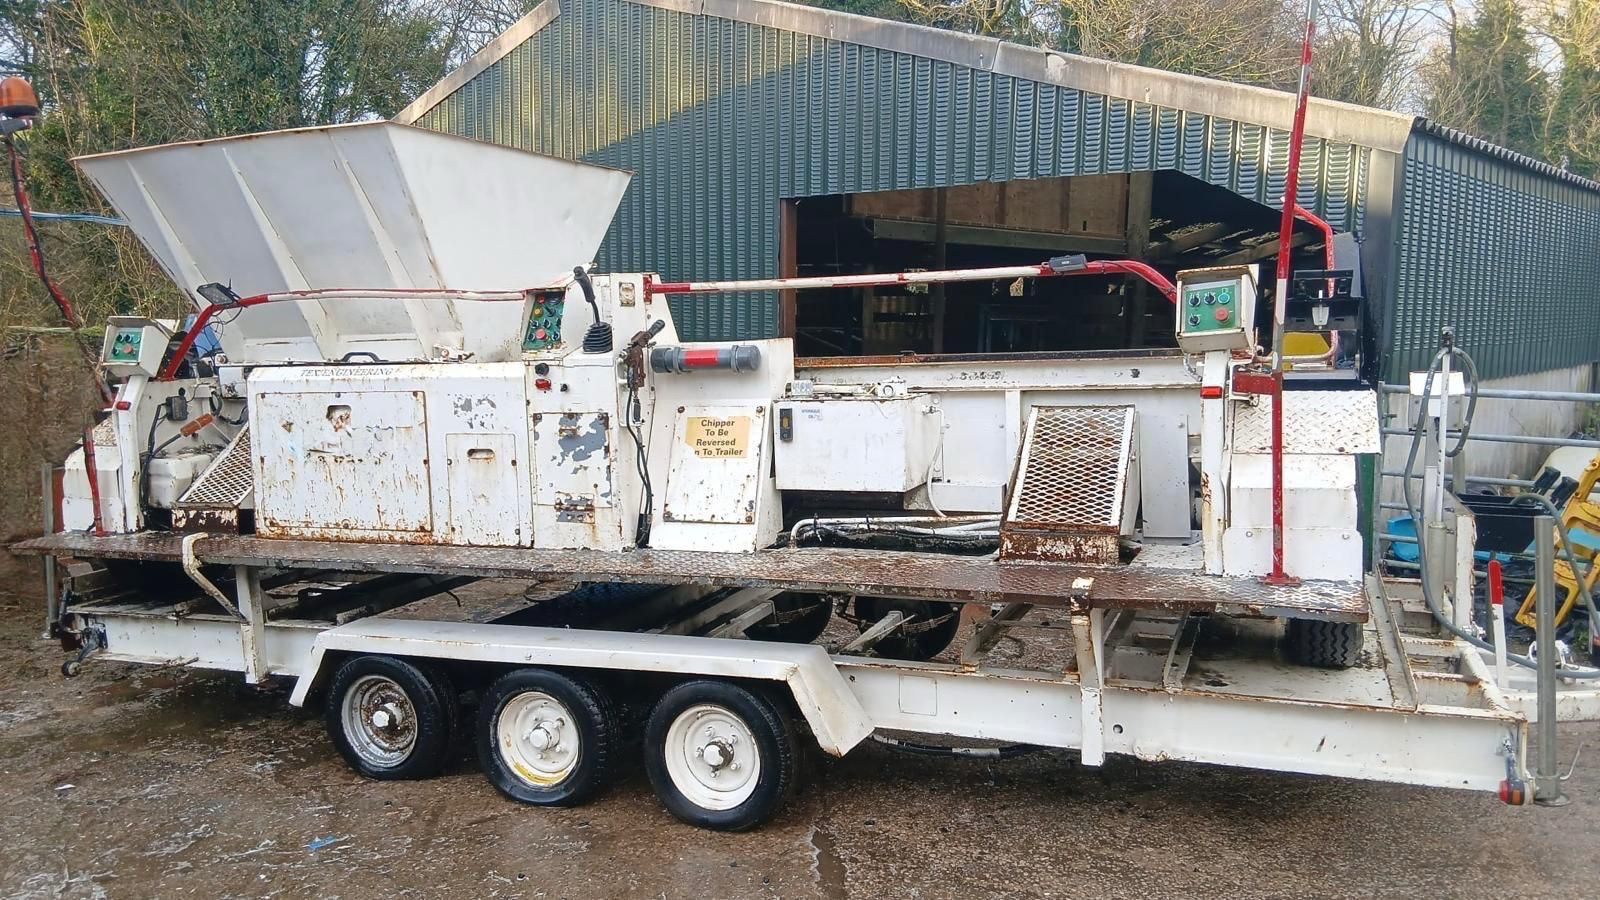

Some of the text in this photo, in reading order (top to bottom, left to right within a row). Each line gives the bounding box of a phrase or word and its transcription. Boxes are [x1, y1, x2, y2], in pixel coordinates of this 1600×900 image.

[321, 367, 393, 377] ENGINEERING
[701, 419, 735, 428] Chipper
[696, 438, 736, 447] Reversed
[702, 448, 713, 456] To
[715, 448, 743, 456] Trailer
